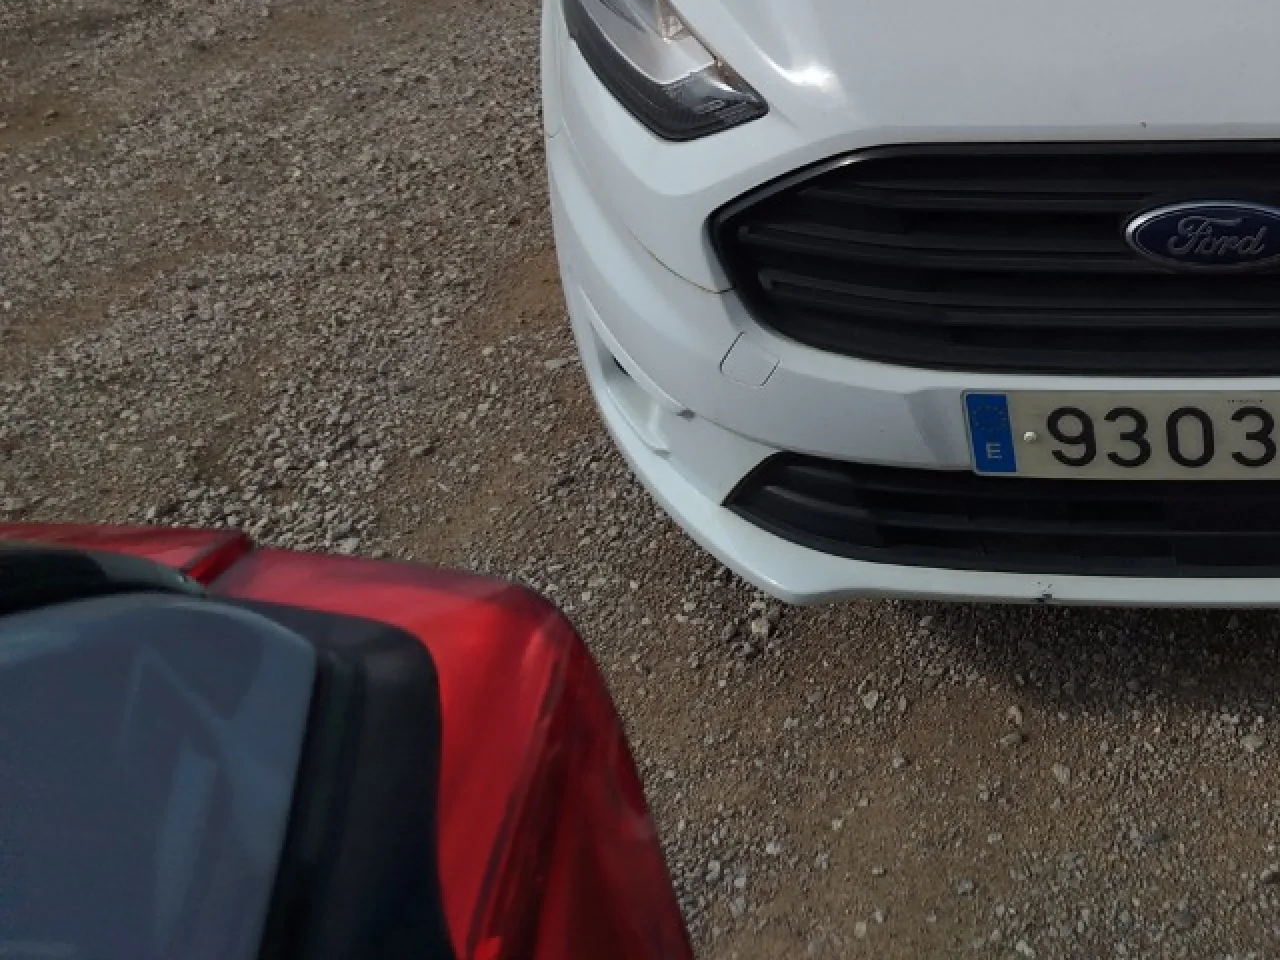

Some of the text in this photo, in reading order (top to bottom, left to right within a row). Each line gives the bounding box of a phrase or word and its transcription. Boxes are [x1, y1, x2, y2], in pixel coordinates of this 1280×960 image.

[1168, 215, 1265, 256] Ford
[985, 442, 1003, 459] E
[1046, 405, 1278, 468] 9303
